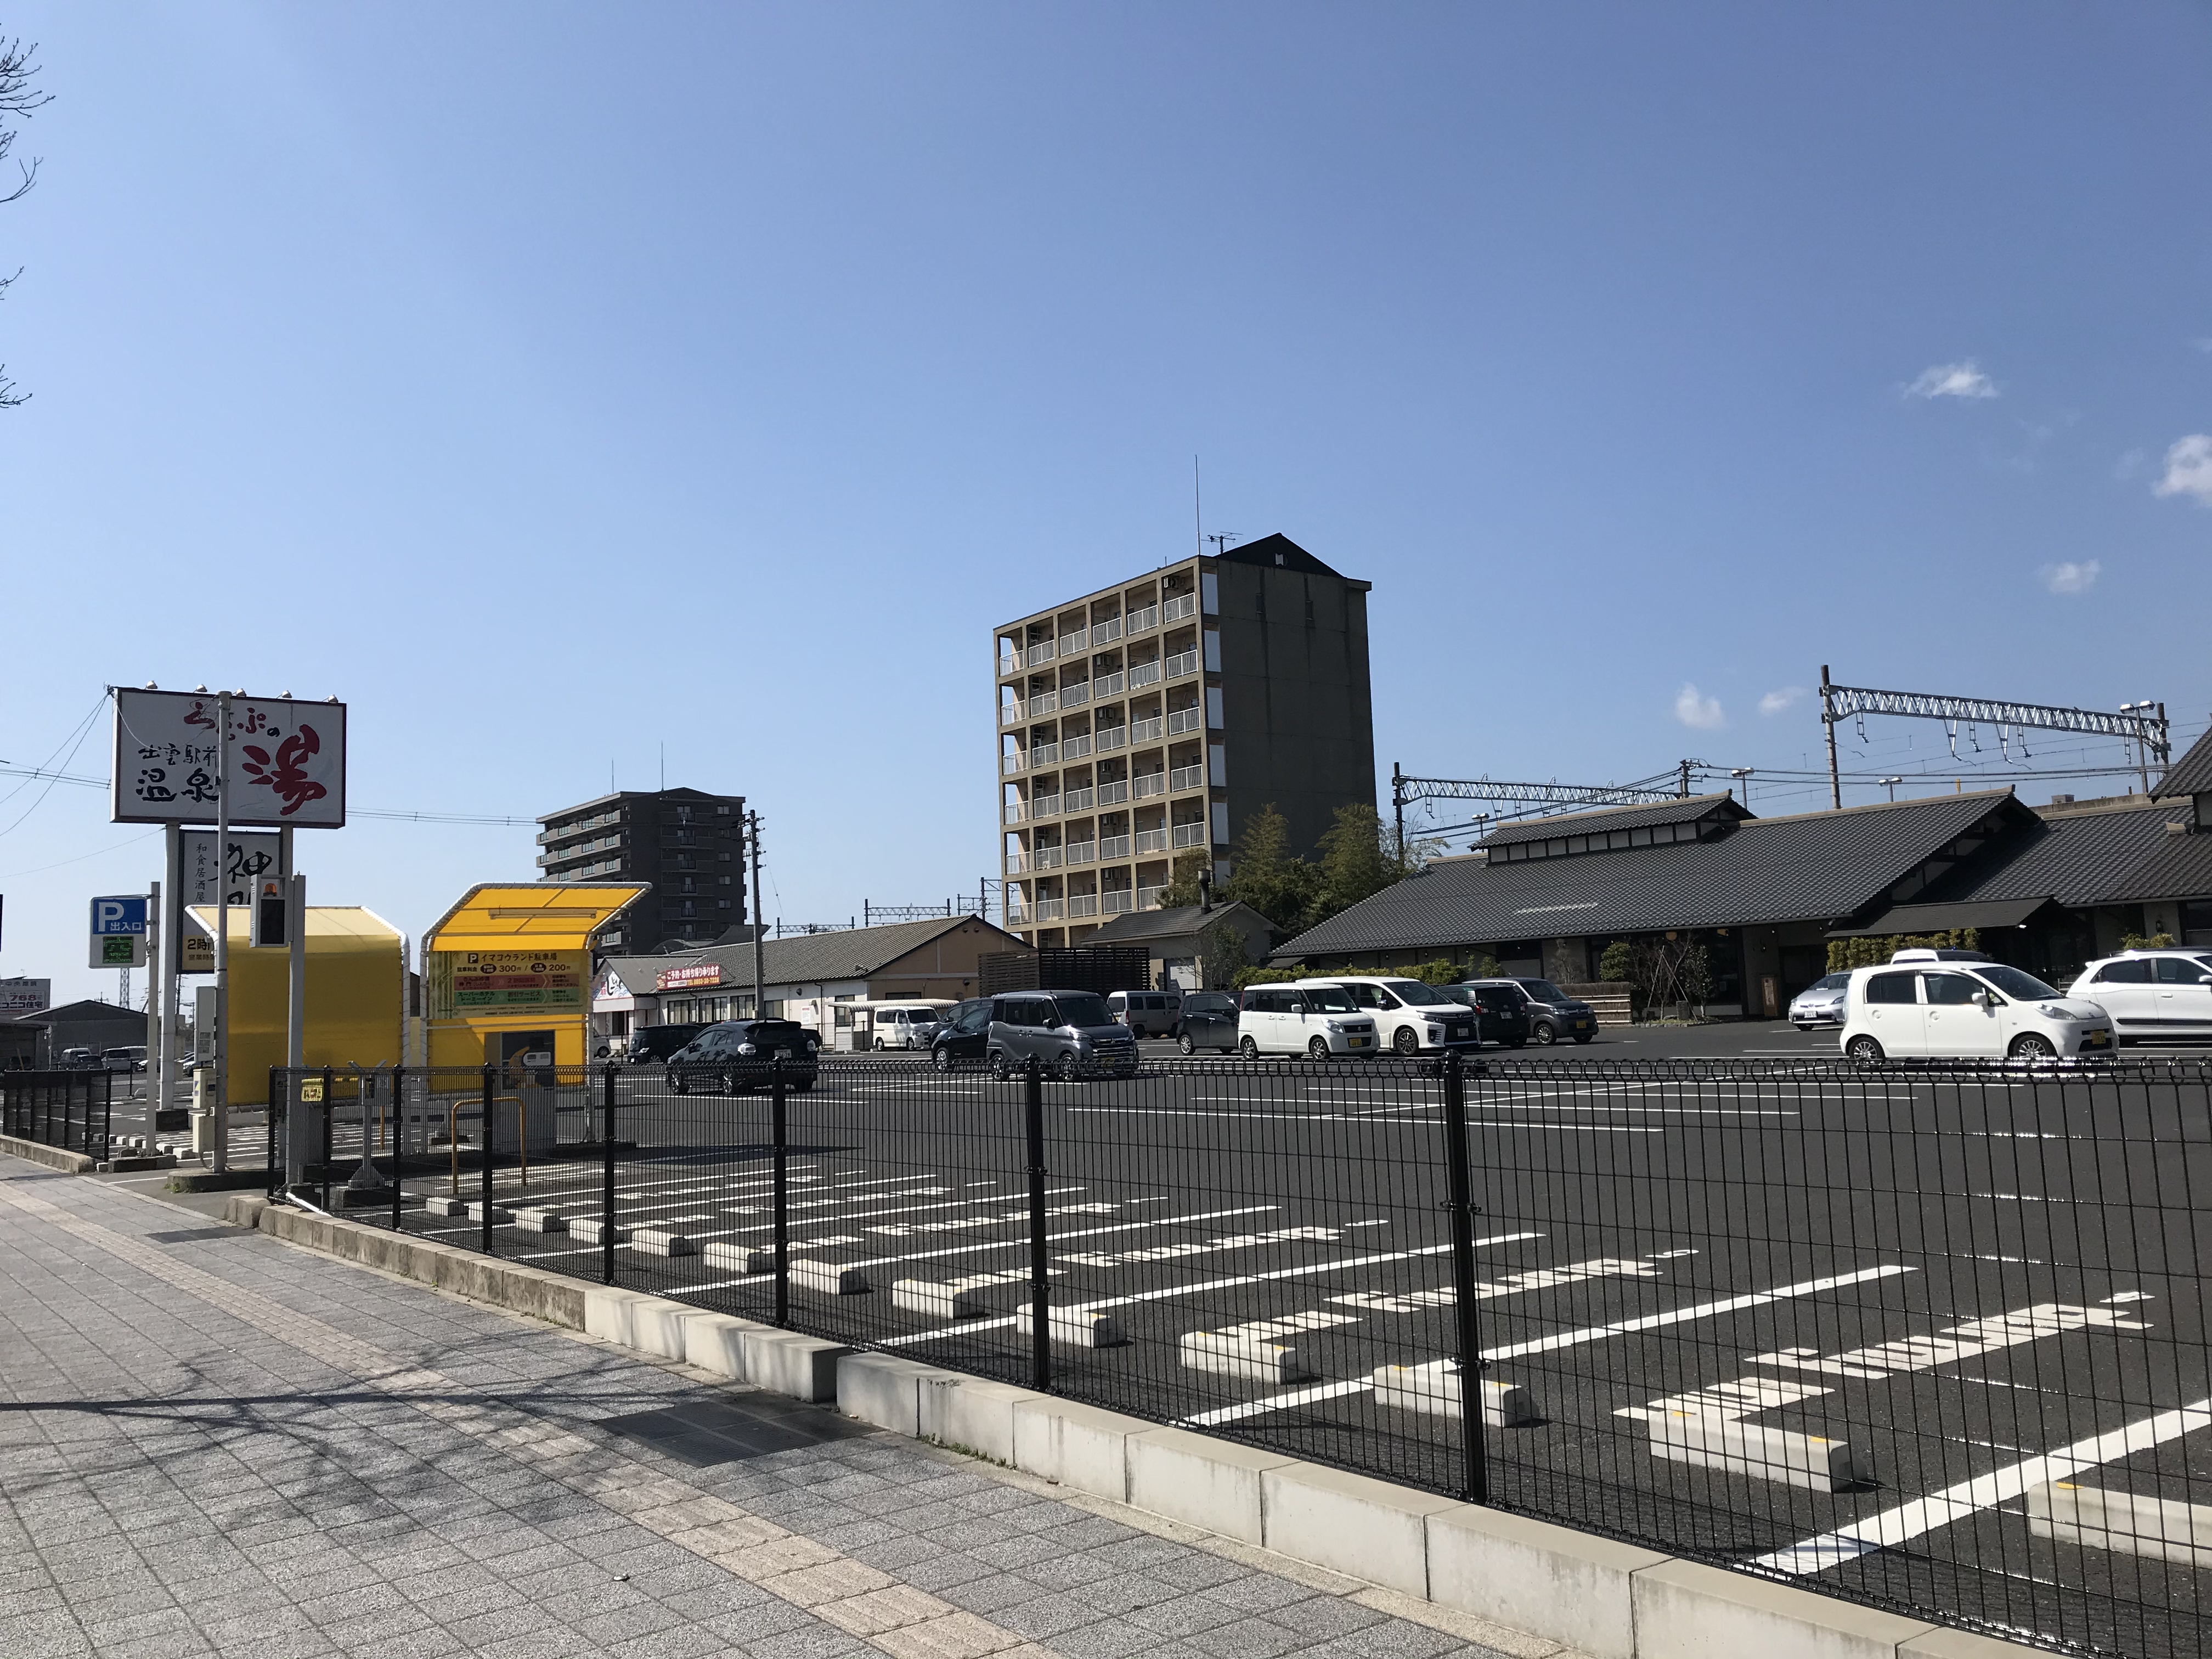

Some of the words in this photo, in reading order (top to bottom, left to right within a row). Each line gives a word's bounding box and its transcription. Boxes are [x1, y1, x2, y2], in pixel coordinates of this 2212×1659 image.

[138, 743, 217, 767] 出雲駅前
[136, 767, 220, 803] 温泉
[195, 843, 207, 902] 和食居酒屋
[98, 902, 124, 932] P
[110, 922, 142, 931] 出入口
[470, 954, 477, 963] P
[482, 952, 557, 962] イマコウランド駐車場
